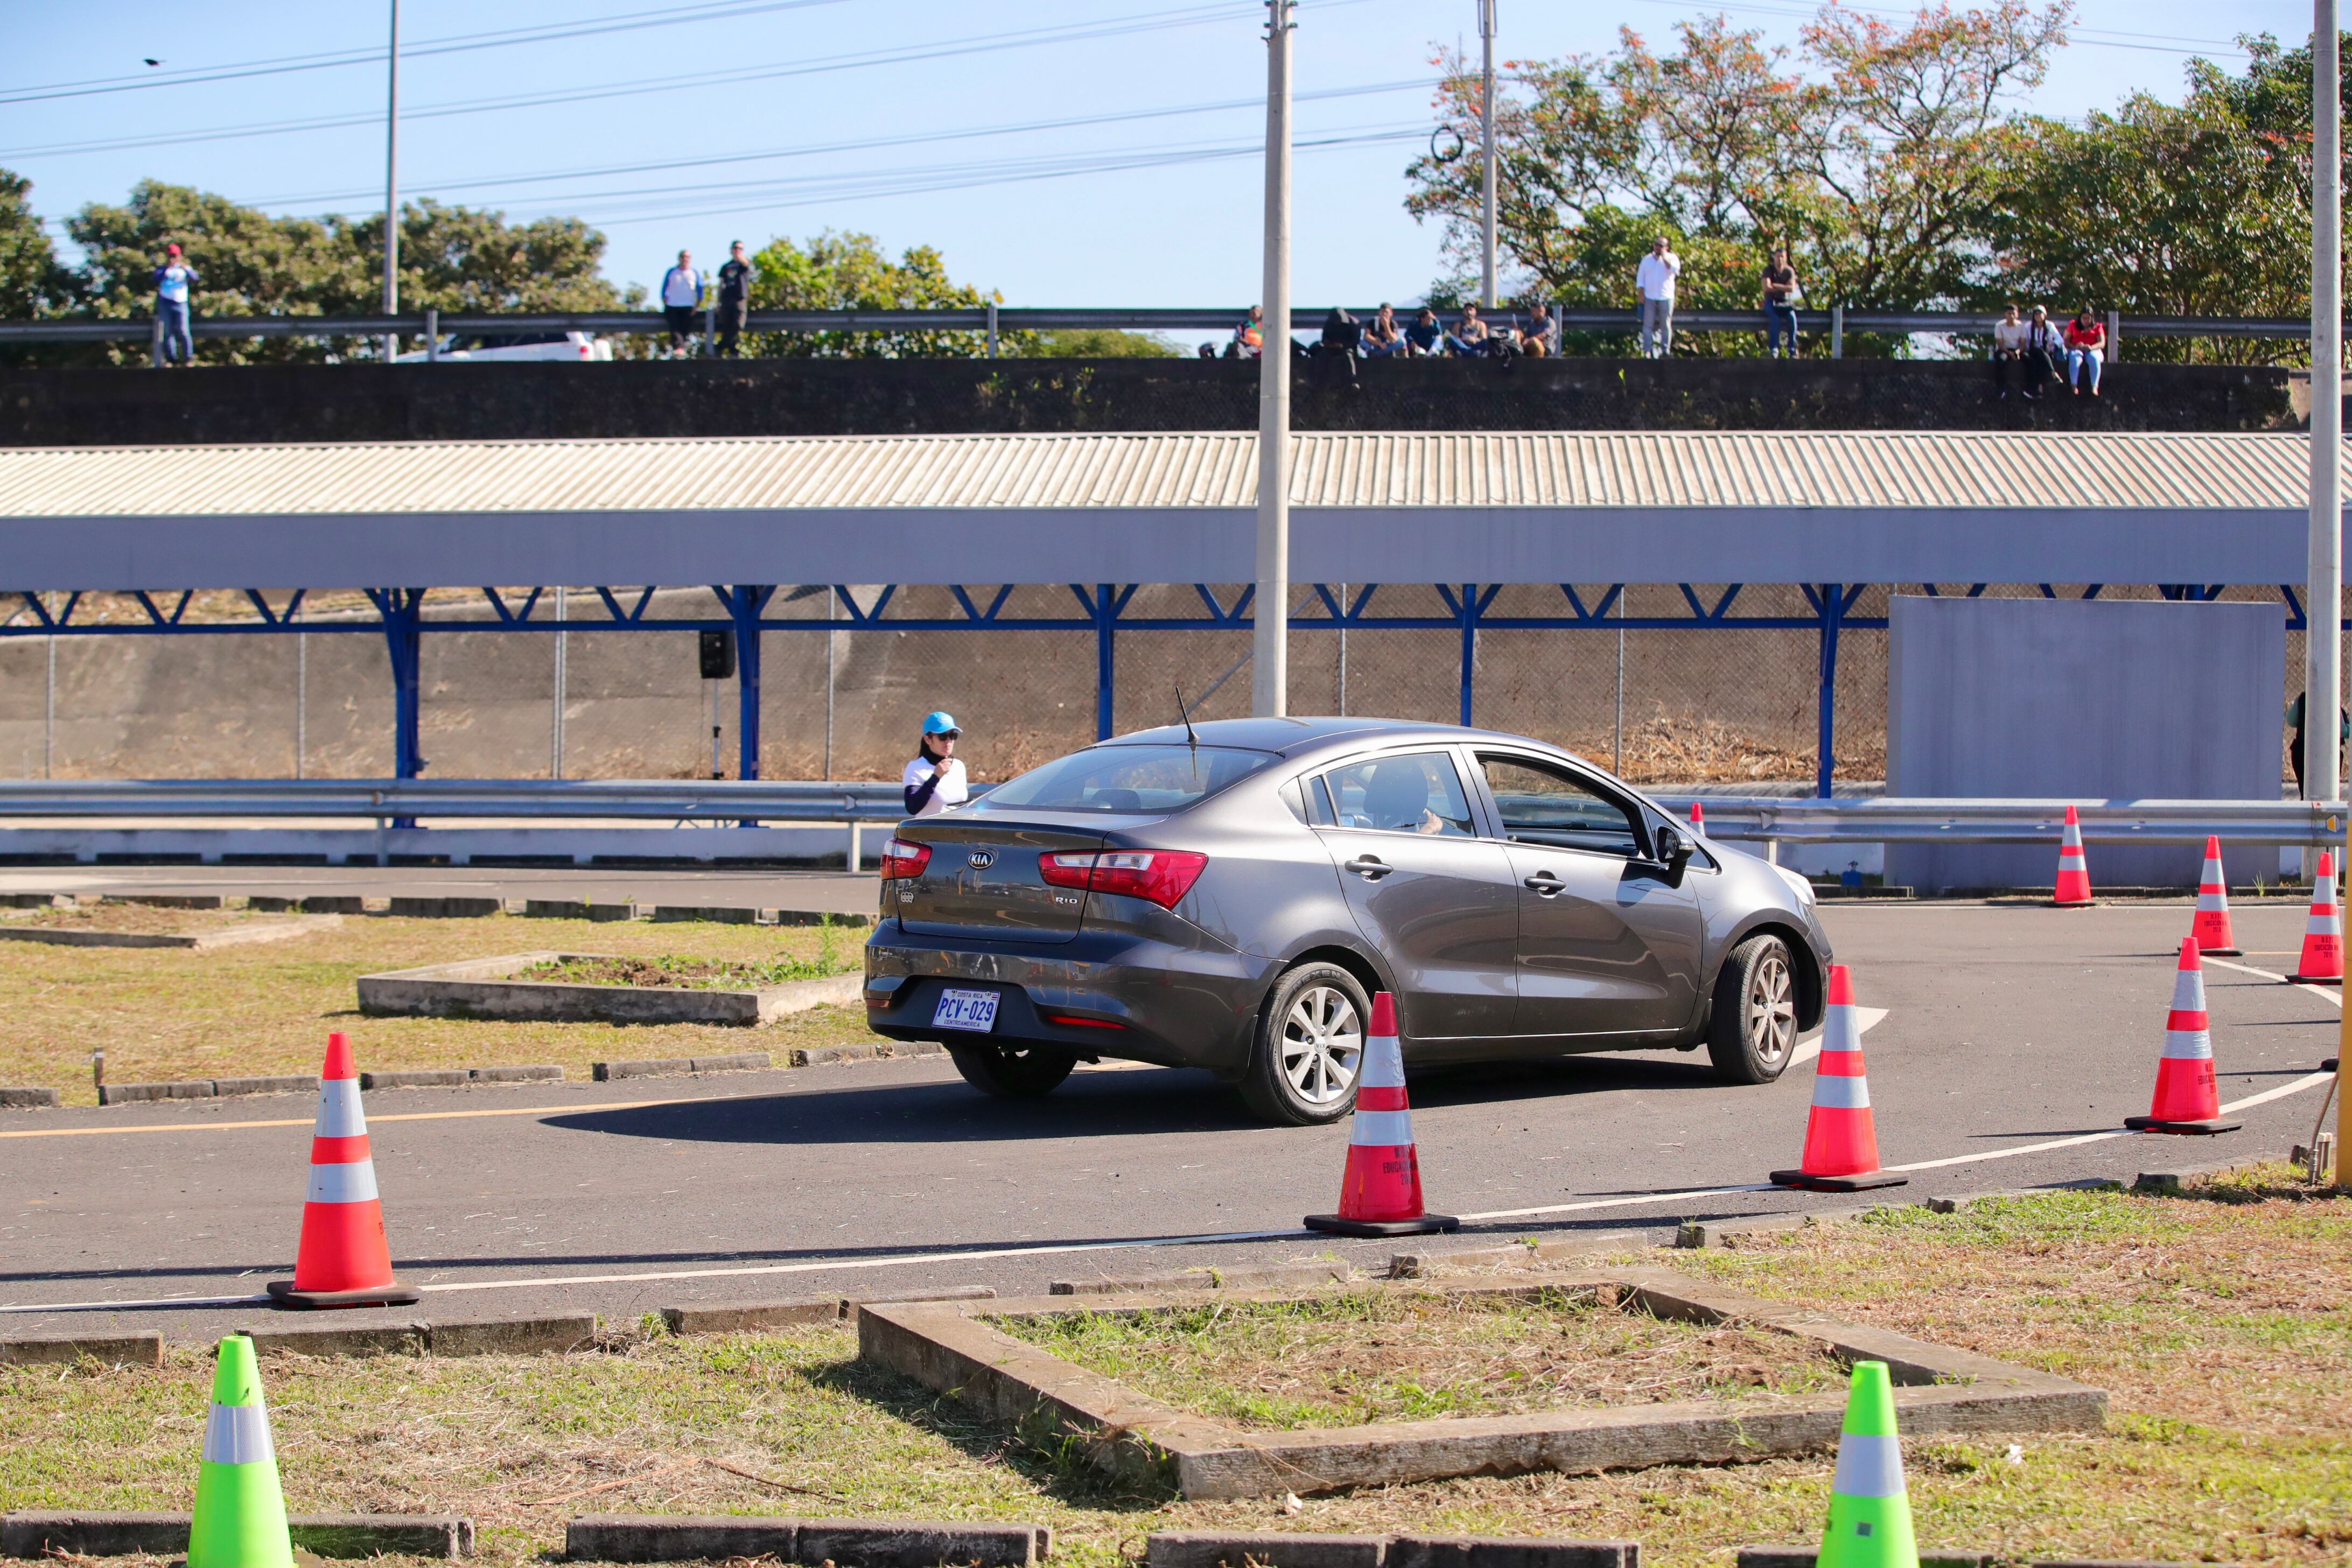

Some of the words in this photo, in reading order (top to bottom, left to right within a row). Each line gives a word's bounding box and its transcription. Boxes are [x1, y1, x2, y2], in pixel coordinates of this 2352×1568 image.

[971, 855, 988, 865] KIA
[1292, 969, 1341, 992] NEXEN
[937, 997, 994, 1022] PCV-029
[943, 1019, 981, 1027] CENTROAMERICA
